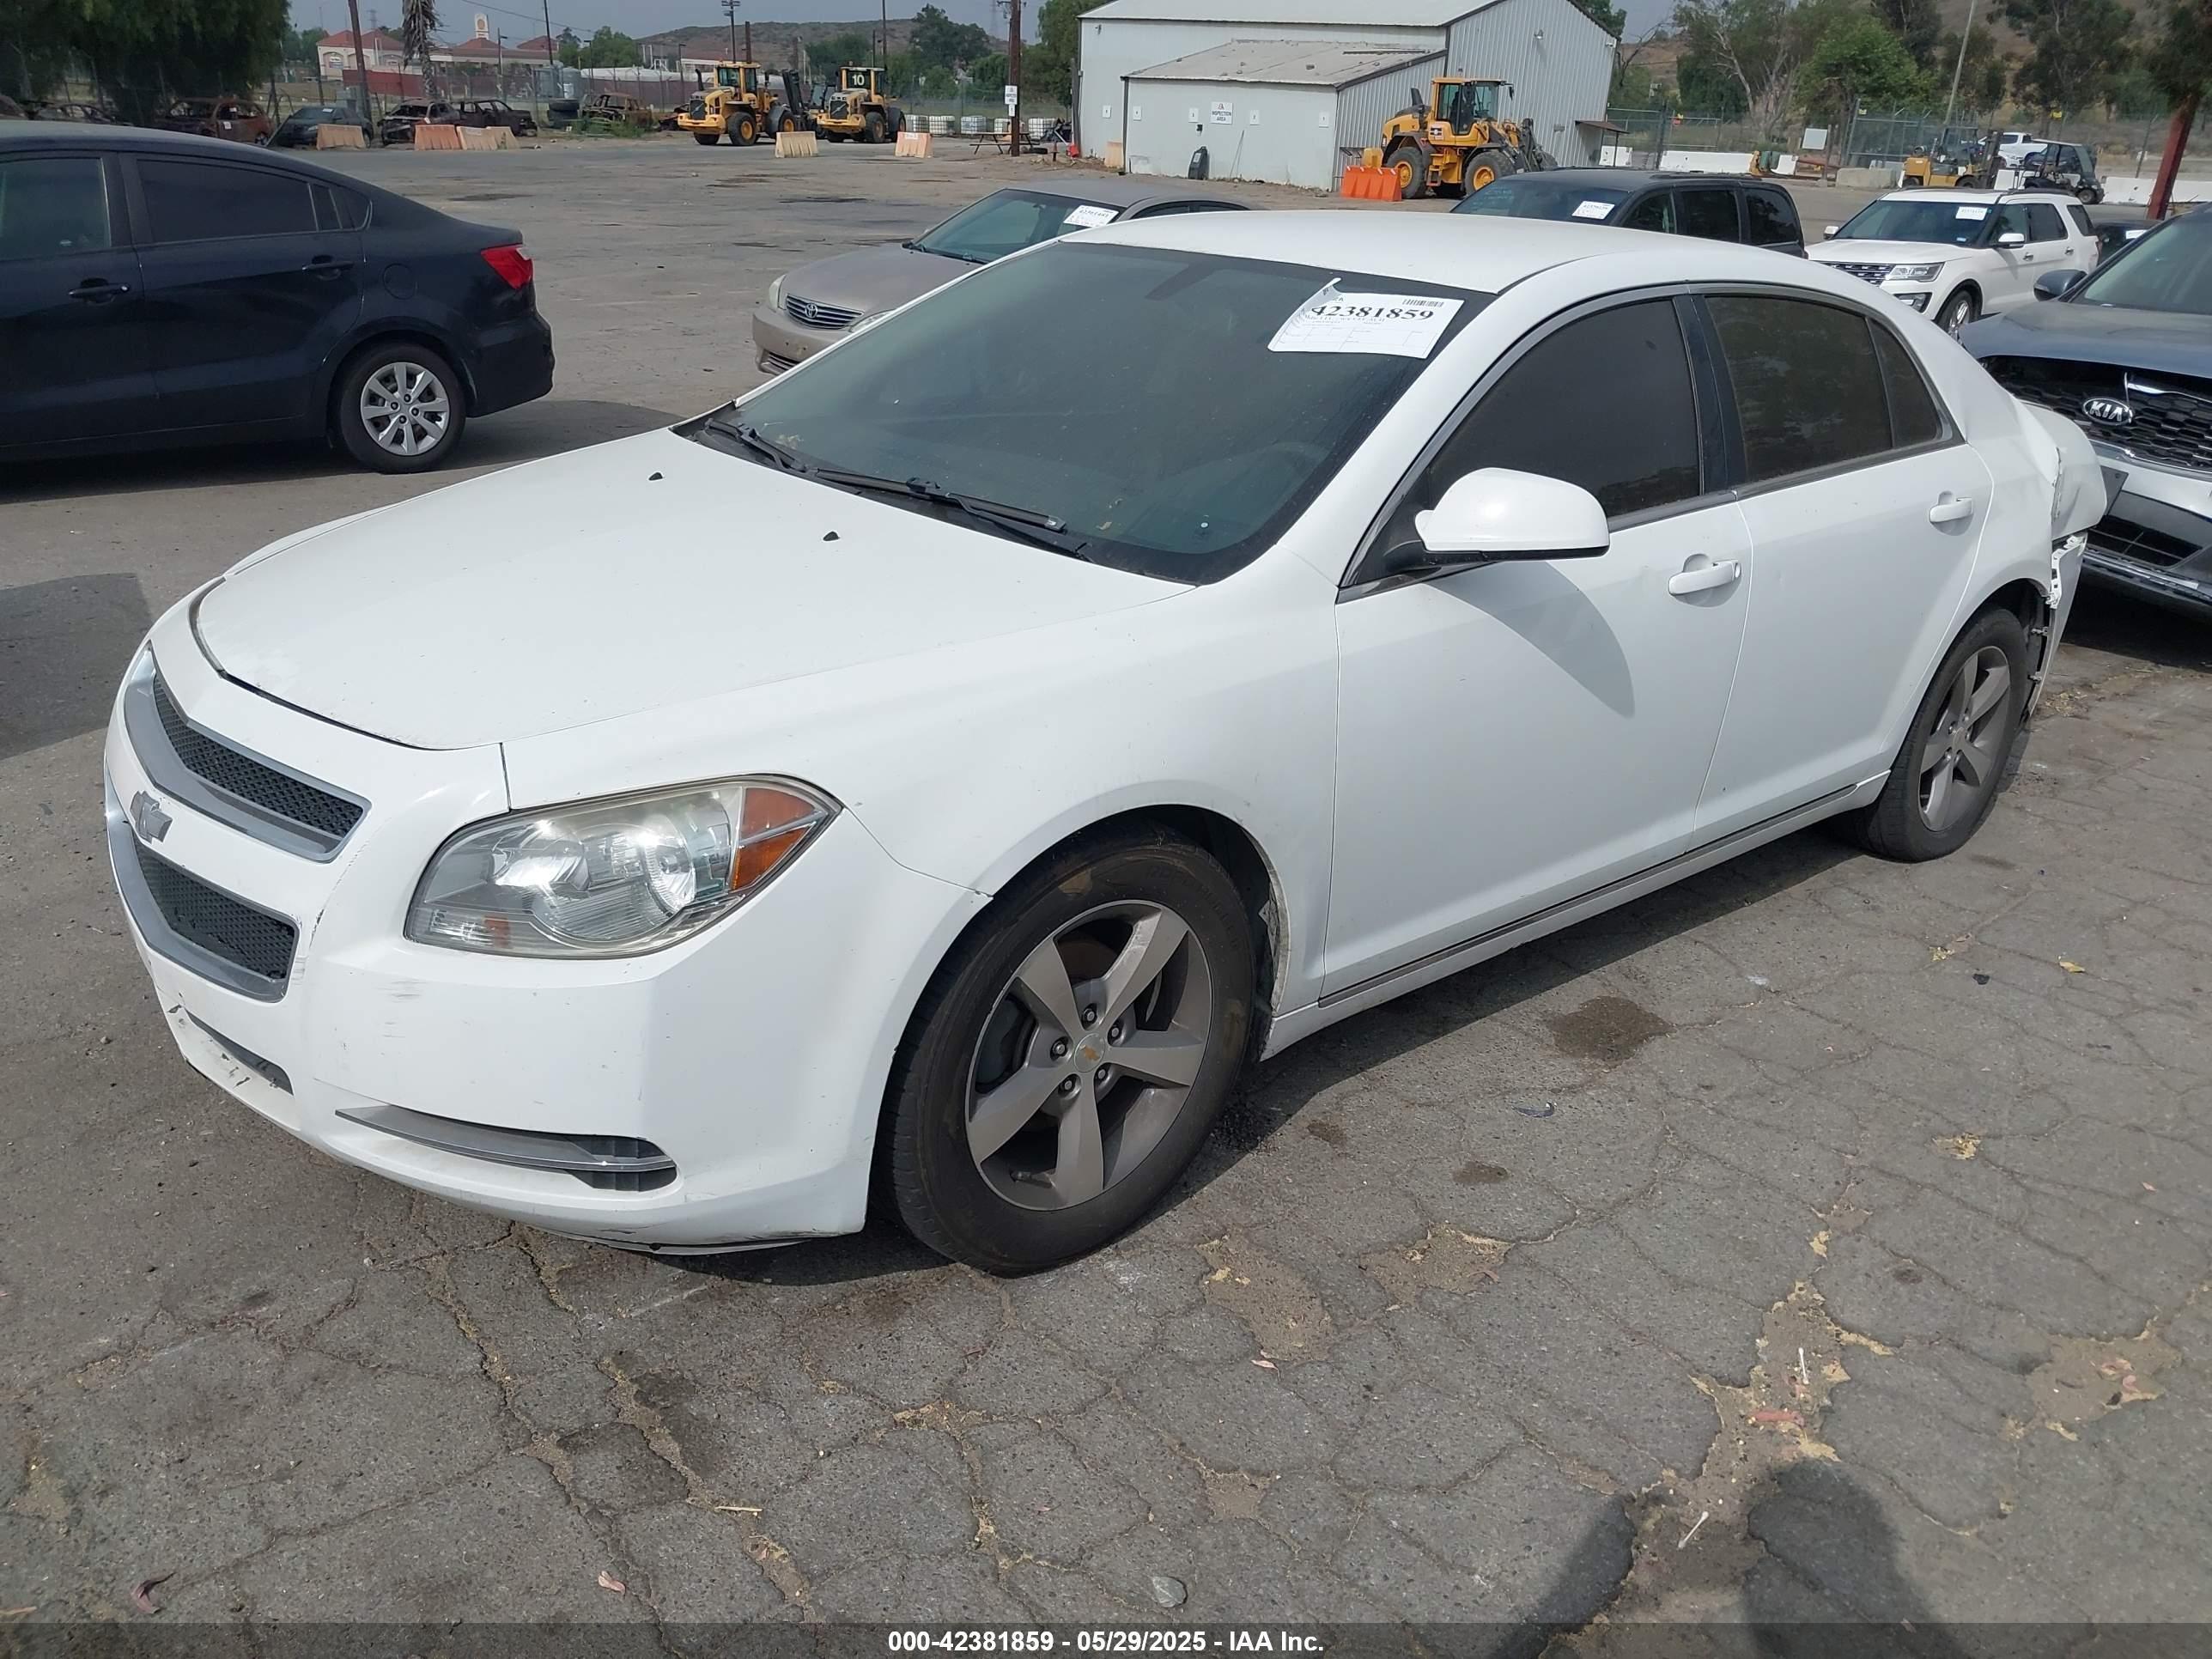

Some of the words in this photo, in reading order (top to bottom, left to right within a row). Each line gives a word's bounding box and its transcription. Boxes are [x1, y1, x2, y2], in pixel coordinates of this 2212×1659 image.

[852, 74, 865, 86] 10
[1310, 304, 1434, 321] 42381859
[2089, 401, 2123, 422] KIA
